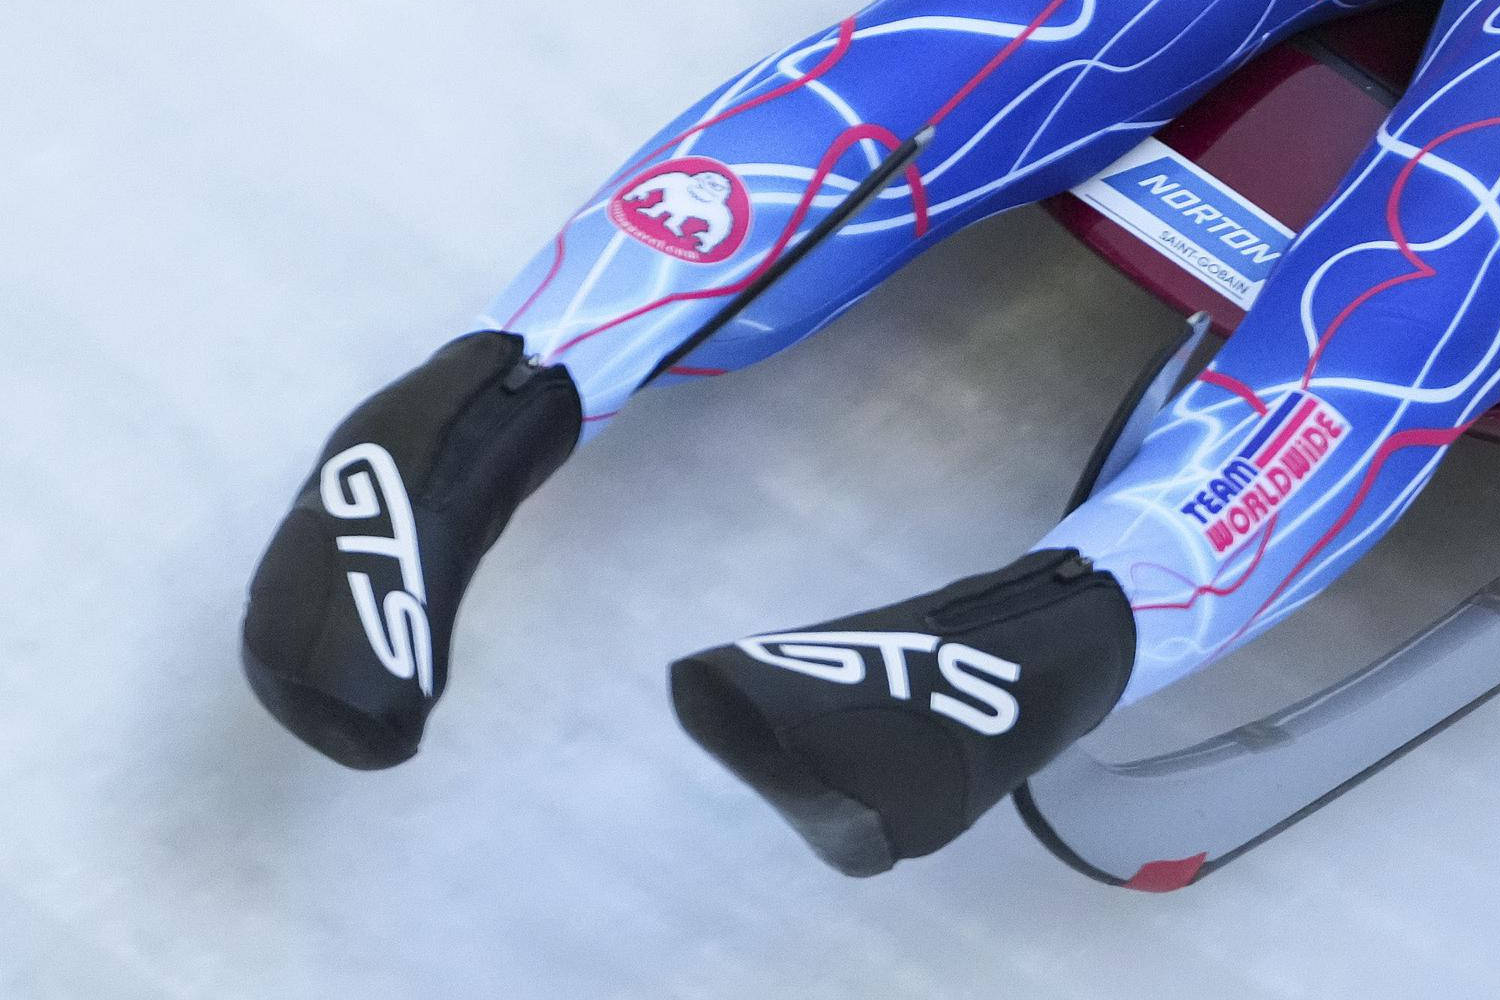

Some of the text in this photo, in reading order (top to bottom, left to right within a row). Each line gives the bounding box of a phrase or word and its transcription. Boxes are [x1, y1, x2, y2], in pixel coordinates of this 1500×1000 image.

[1138, 174, 1282, 264] NORTON
[1159, 230, 1250, 294] SAINT-GOBAIN
[1181, 460, 1258, 524] TEAM
[320, 442, 433, 699] GTS
[735, 631, 1020, 736] GTS
